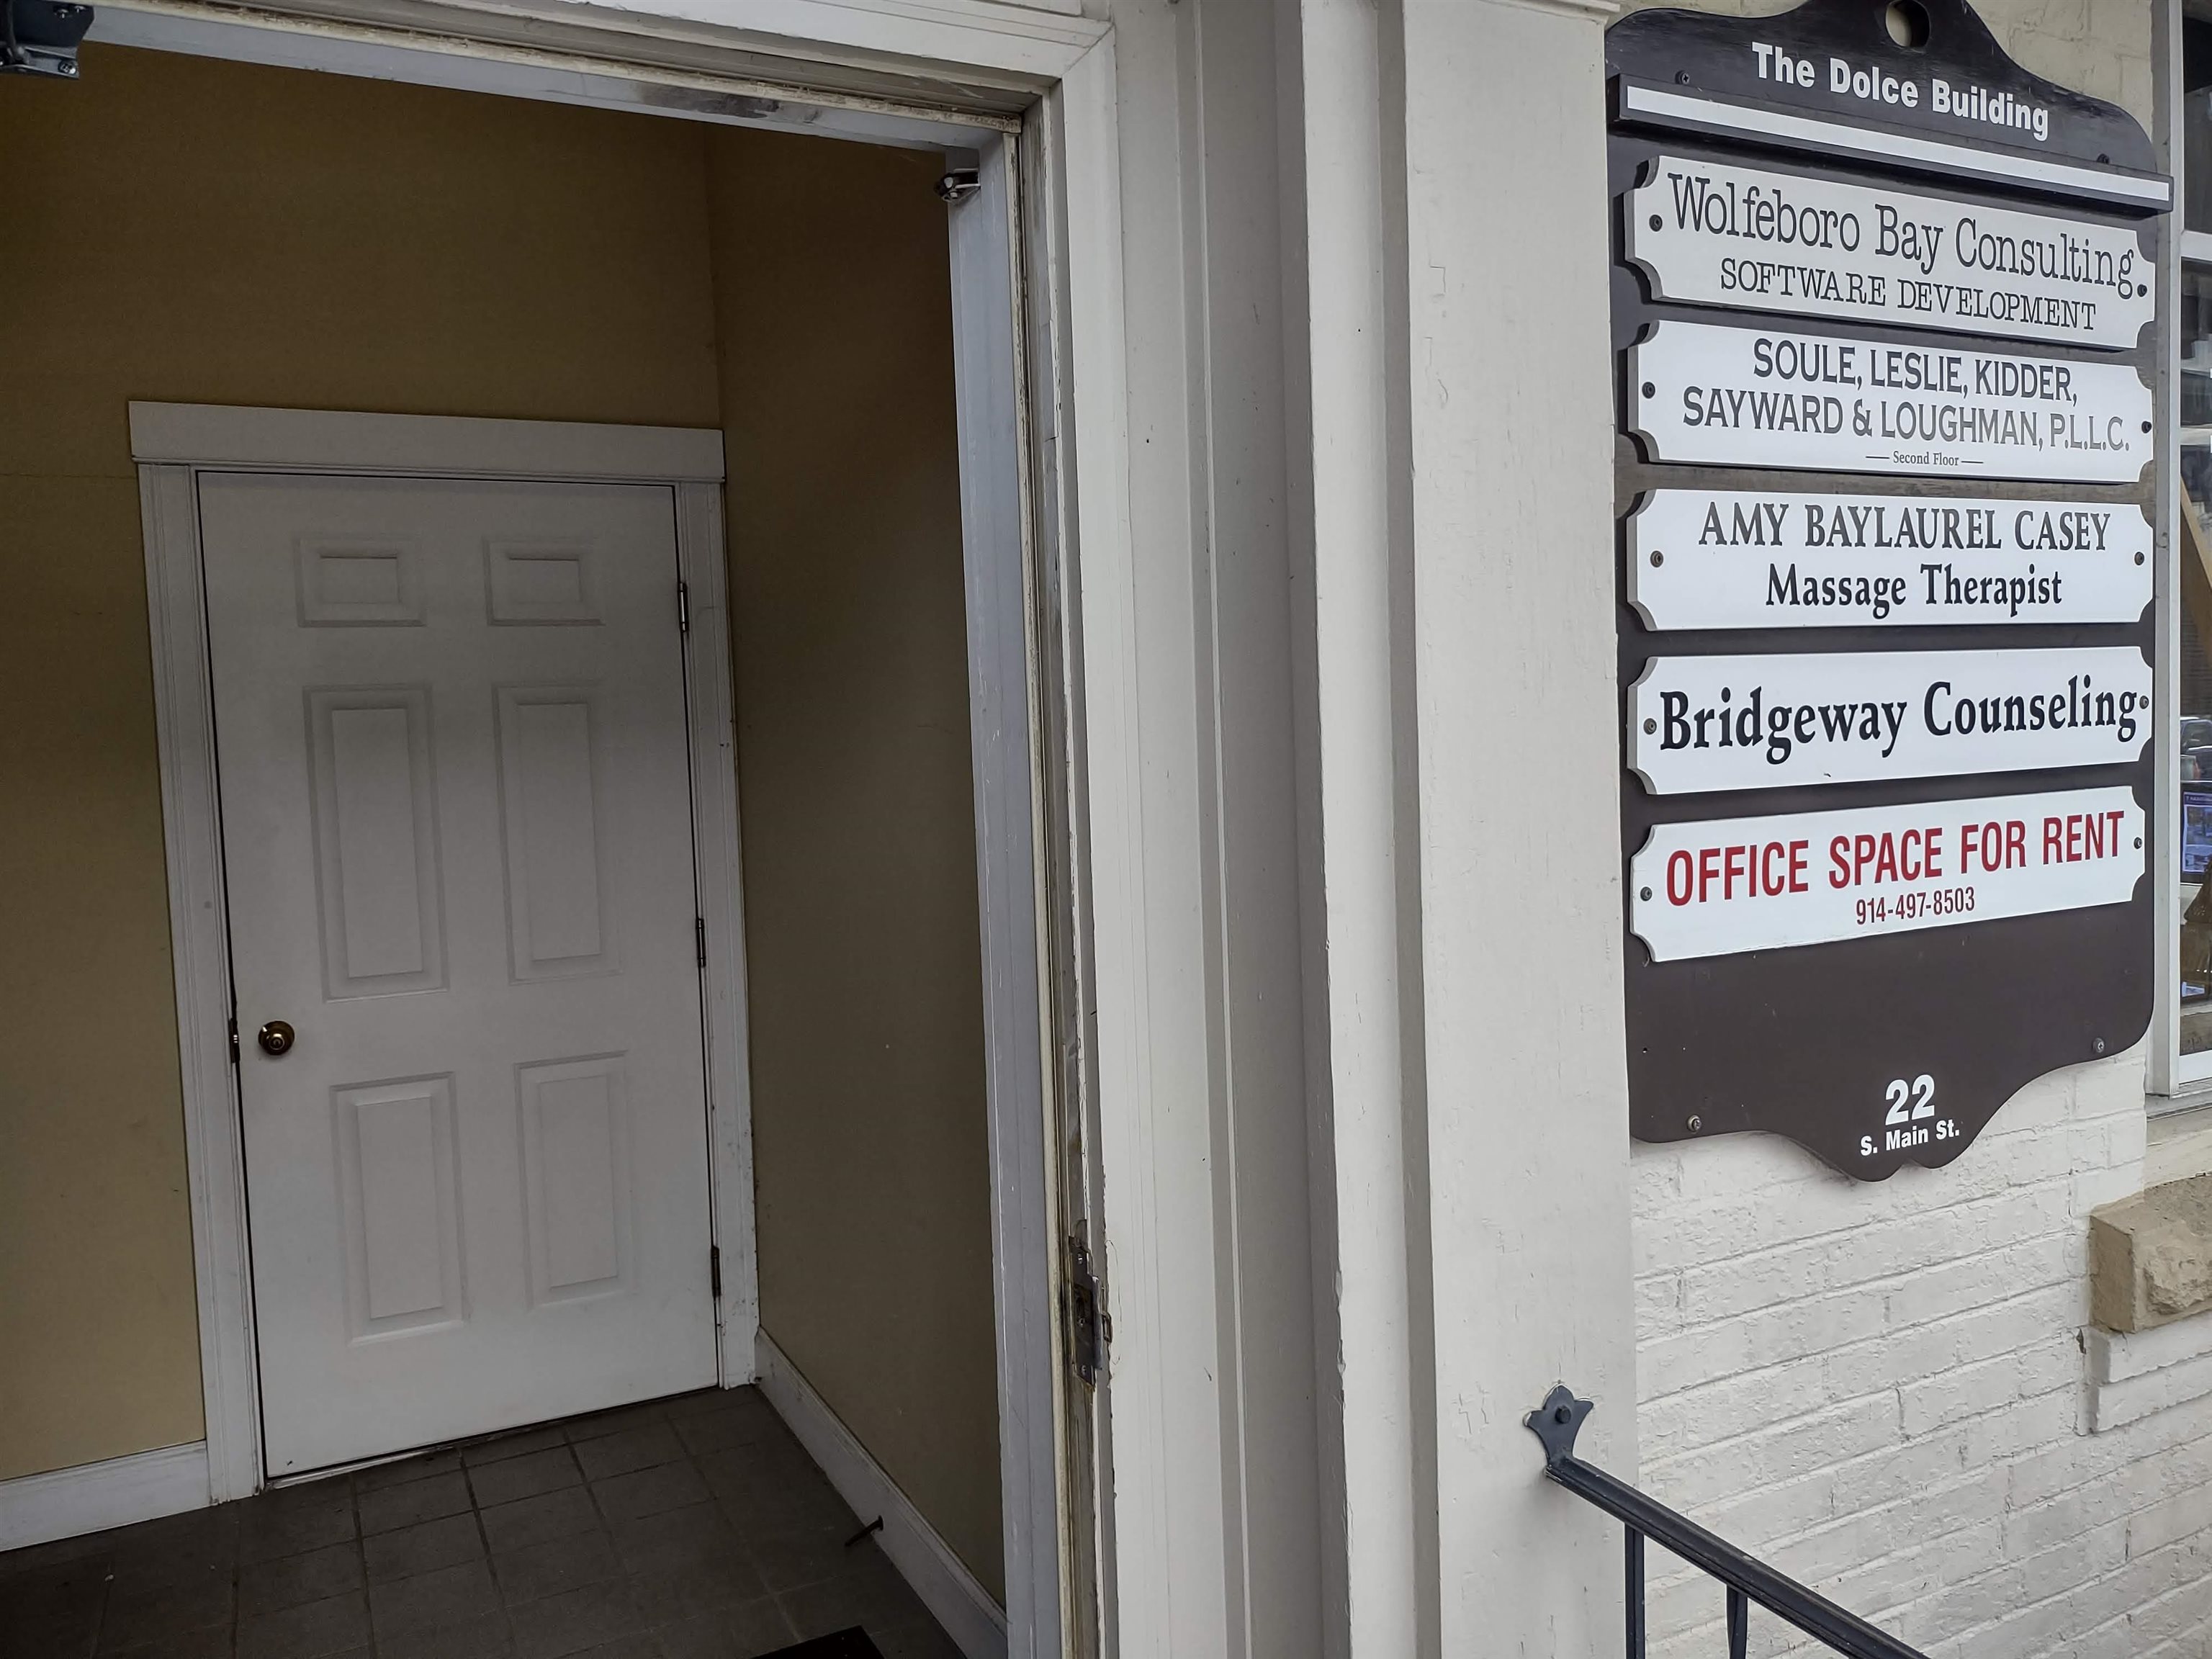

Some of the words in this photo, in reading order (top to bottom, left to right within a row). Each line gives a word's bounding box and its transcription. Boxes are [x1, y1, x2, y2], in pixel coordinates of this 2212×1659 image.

[1753, 42, 1815, 87] The
[1830, 58, 1918, 107] Dolce
[1933, 79, 2048, 141] Building
[1668, 173, 1859, 251] Wolfeboro
[1875, 204, 1943, 274] Bay
[1956, 218, 2134, 299] Consulting
[1721, 258, 1885, 306] SOFTWARE
[1897, 279, 2095, 330] DEVELOPMENT
[1754, 338, 1861, 390] SOULE,
[1871, 350, 1967, 398] LESLIE,
[1975, 359, 2077, 407] KIDDER,
[1683, 386, 1843, 433] SAYWARD
[1853, 399, 1873, 436] &
[1881, 401, 2043, 451] LOUGHMAN,
[2050, 413, 2128, 451] P.L.L.C.
[1893, 451, 1930, 464] Second
[1933, 452, 1959, 466] Floor
[1699, 502, 1789, 546] AMY
[1805, 505, 2001, 549] BAYLAUREL
[2015, 511, 2110, 550] CASEY
[1766, 564, 1906, 619] Massage
[1920, 564, 2062, 617] Therapist
[1660, 686, 1907, 765] Bridgeway
[1925, 675, 2136, 742] Counseling
[1667, 840, 1808, 906] OFFICE
[1829, 828, 1942, 889] SPACE
[1961, 821, 2026, 873] FOR
[2044, 811, 2124, 865] RENT
[1856, 886, 1974, 925] 914-497-8503
[1885, 1074, 1935, 1125] 22
[1861, 1136, 1877, 1156] S.
[1887, 1125, 1928, 1150] Main
[1936, 1120, 1959, 1139] St.
